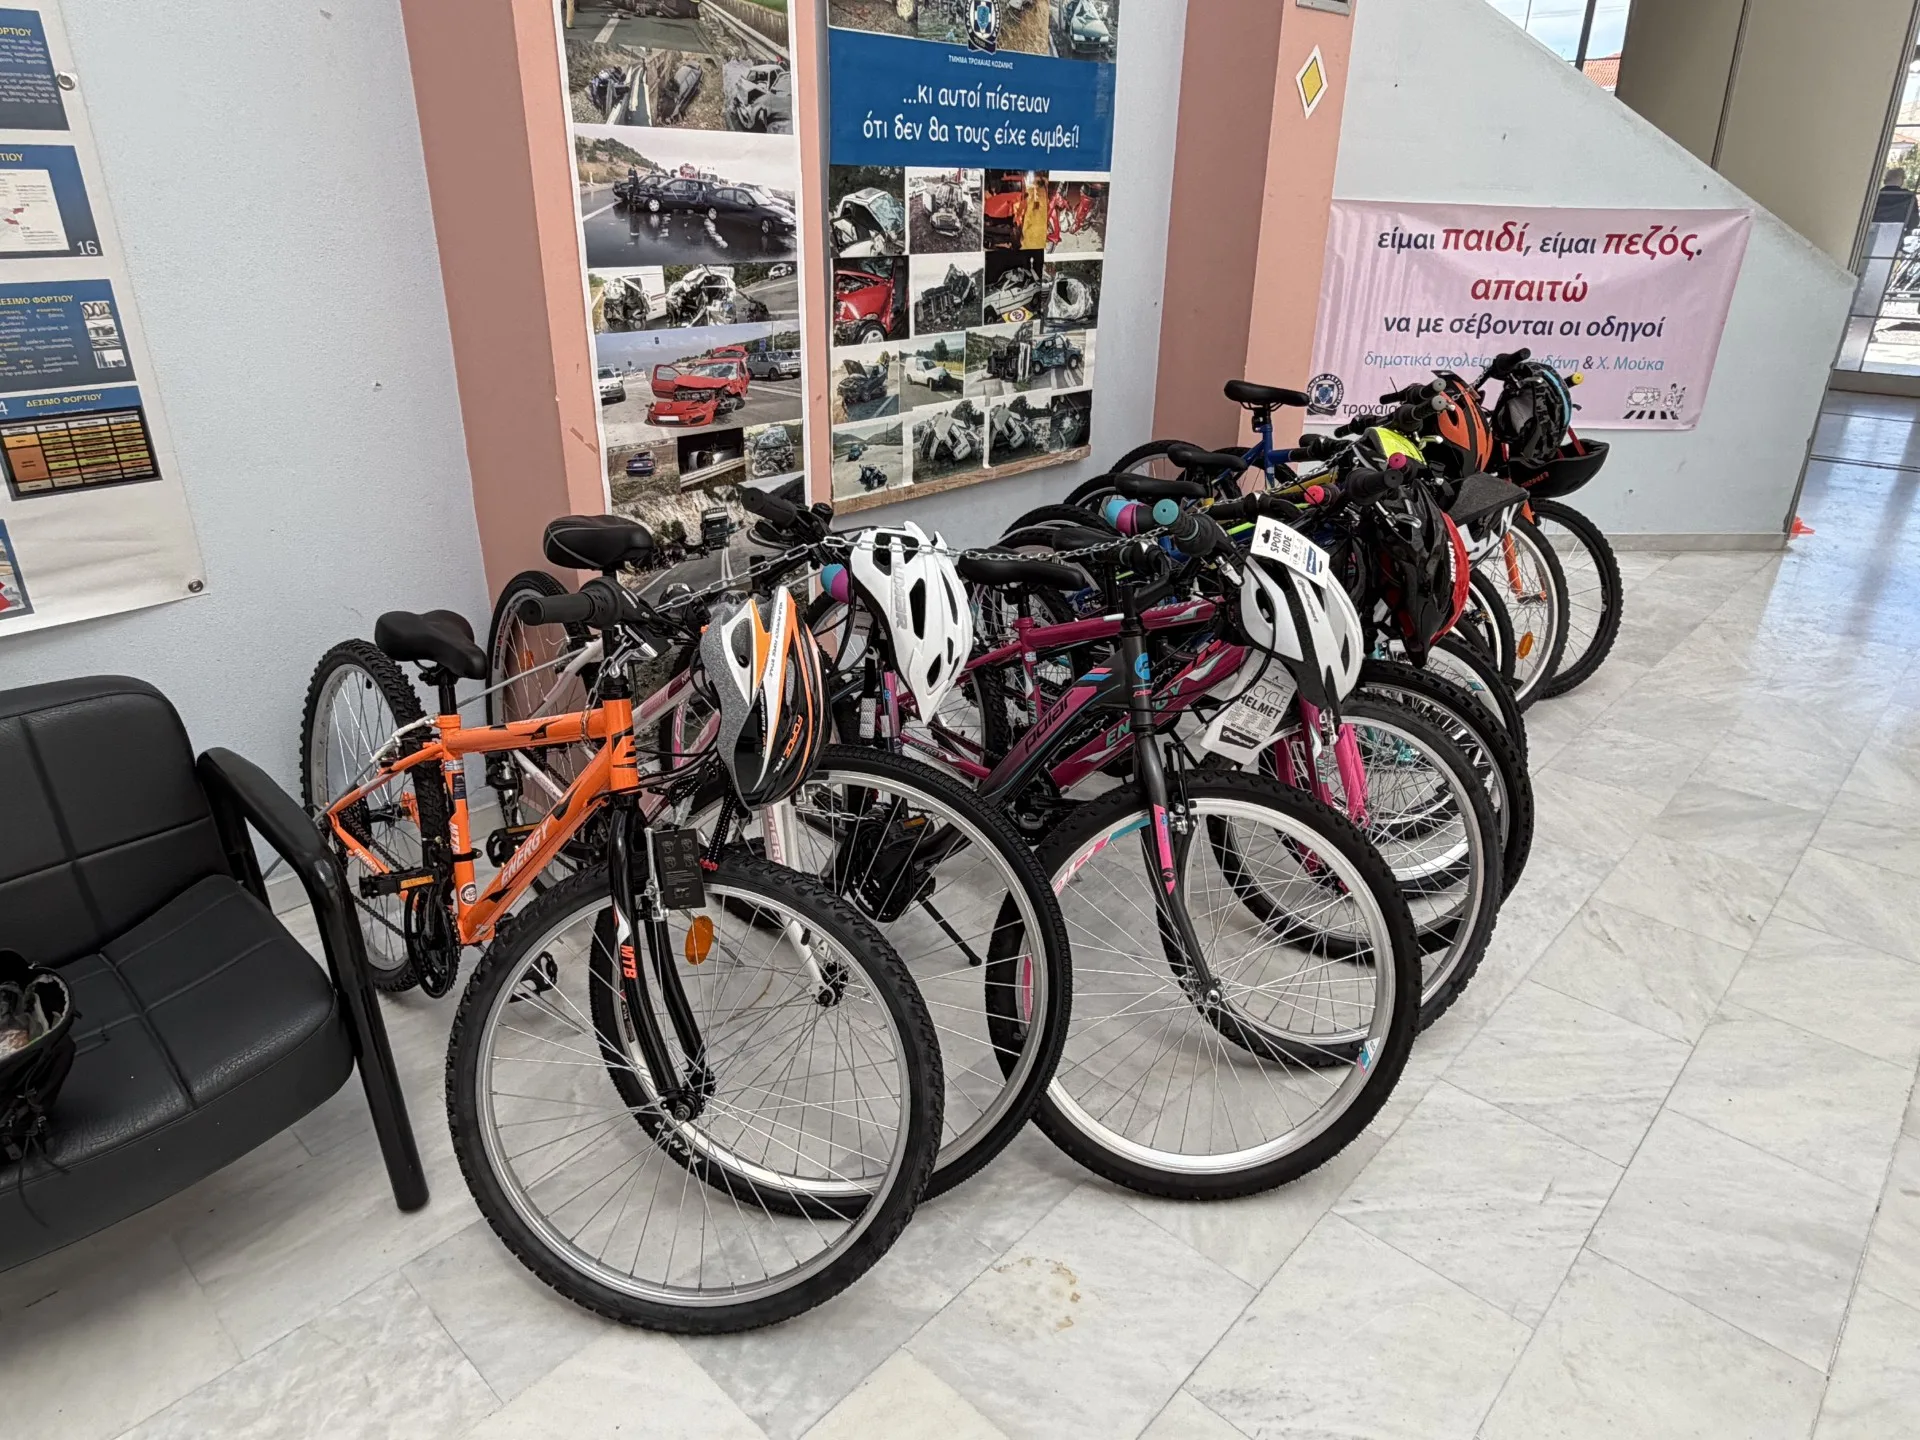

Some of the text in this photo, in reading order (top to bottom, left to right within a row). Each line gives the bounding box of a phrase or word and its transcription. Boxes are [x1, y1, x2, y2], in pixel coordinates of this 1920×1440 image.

[938, 82, 982, 106] αυτοί
[986, 84, 1050, 114] πίστευαν
[864, 110, 1080, 153] ότι δεν θα τους είχε συμβεί!
[79, 241, 98, 255] 16
[1378, 222, 1702, 260] είμαι παιδί, είμαι πεζός.
[32, 295, 74, 304] ΦΟΡΤΙΟΥ
[1470, 273, 1588, 302] απαιτώ
[1384, 313, 1666, 343] να με σέβονται οι οδηγοί
[1364, 351, 1431, 368] δημοτικά
[1583, 356, 1593, 370] &
[1613, 356, 1664, 371] Μούκα
[63, 394, 102, 404] ΦΟΡΤΙΟΥ
[1270, 526, 1283, 554] SPORT
[1282, 535, 1292, 555] RIDE
[1024, 690, 1074, 752] polar
[1239, 694, 1281, 719] HELMET
[501, 820, 552, 886] ENERGY
[620, 944, 638, 979] MTB
